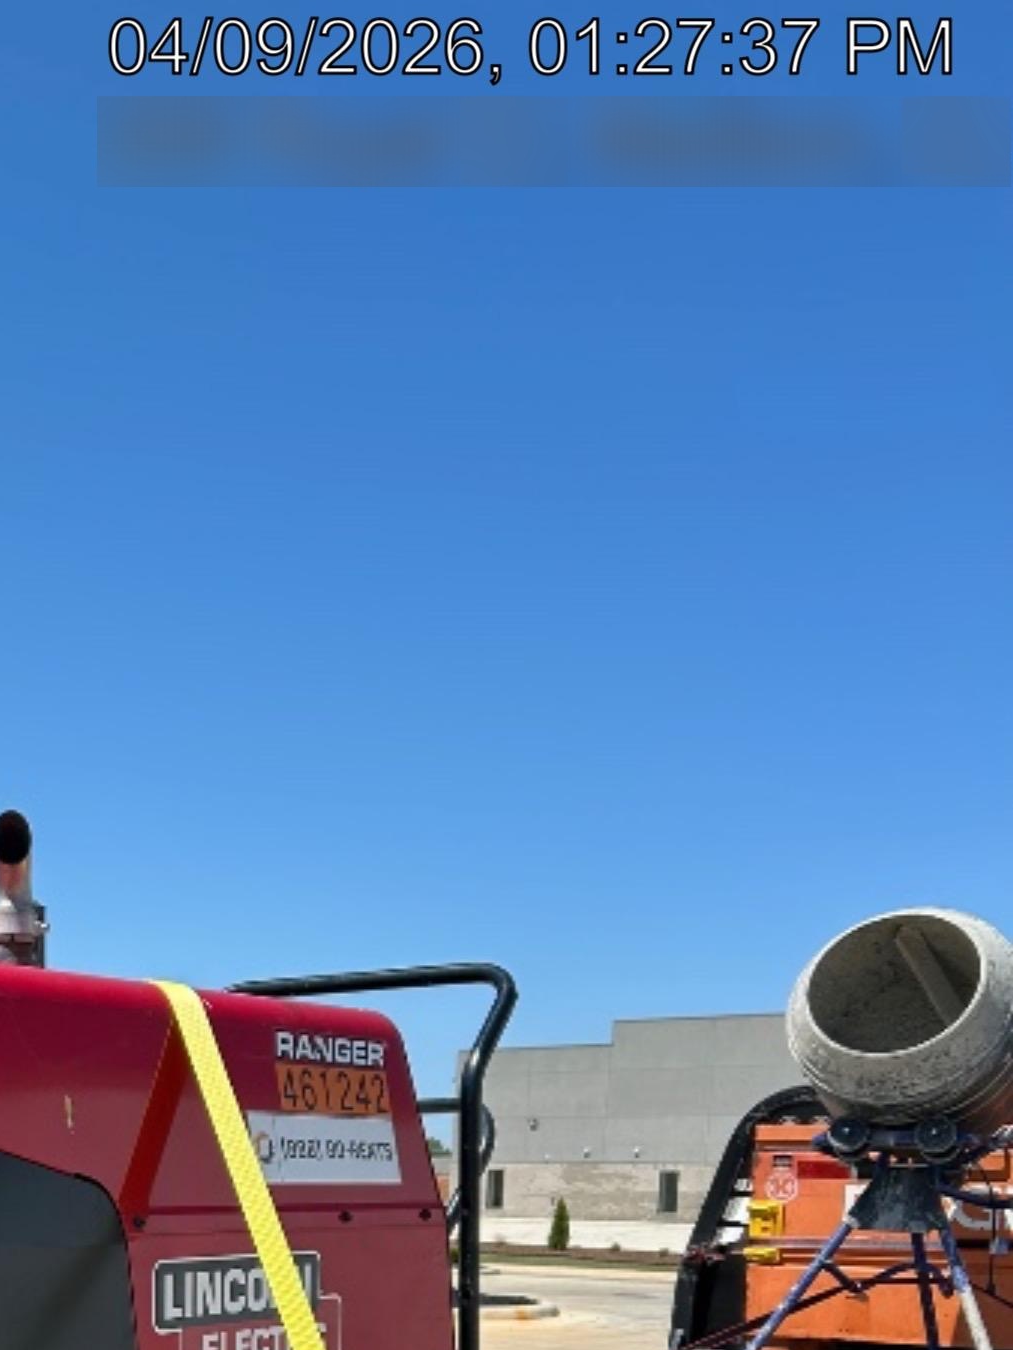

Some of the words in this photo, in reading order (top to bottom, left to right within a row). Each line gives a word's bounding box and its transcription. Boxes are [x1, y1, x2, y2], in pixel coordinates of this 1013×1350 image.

[275, 1030, 385, 1068] RANGER
[282, 1068, 389, 1113] 461242
[162, 1261, 313, 1322] LINCO
